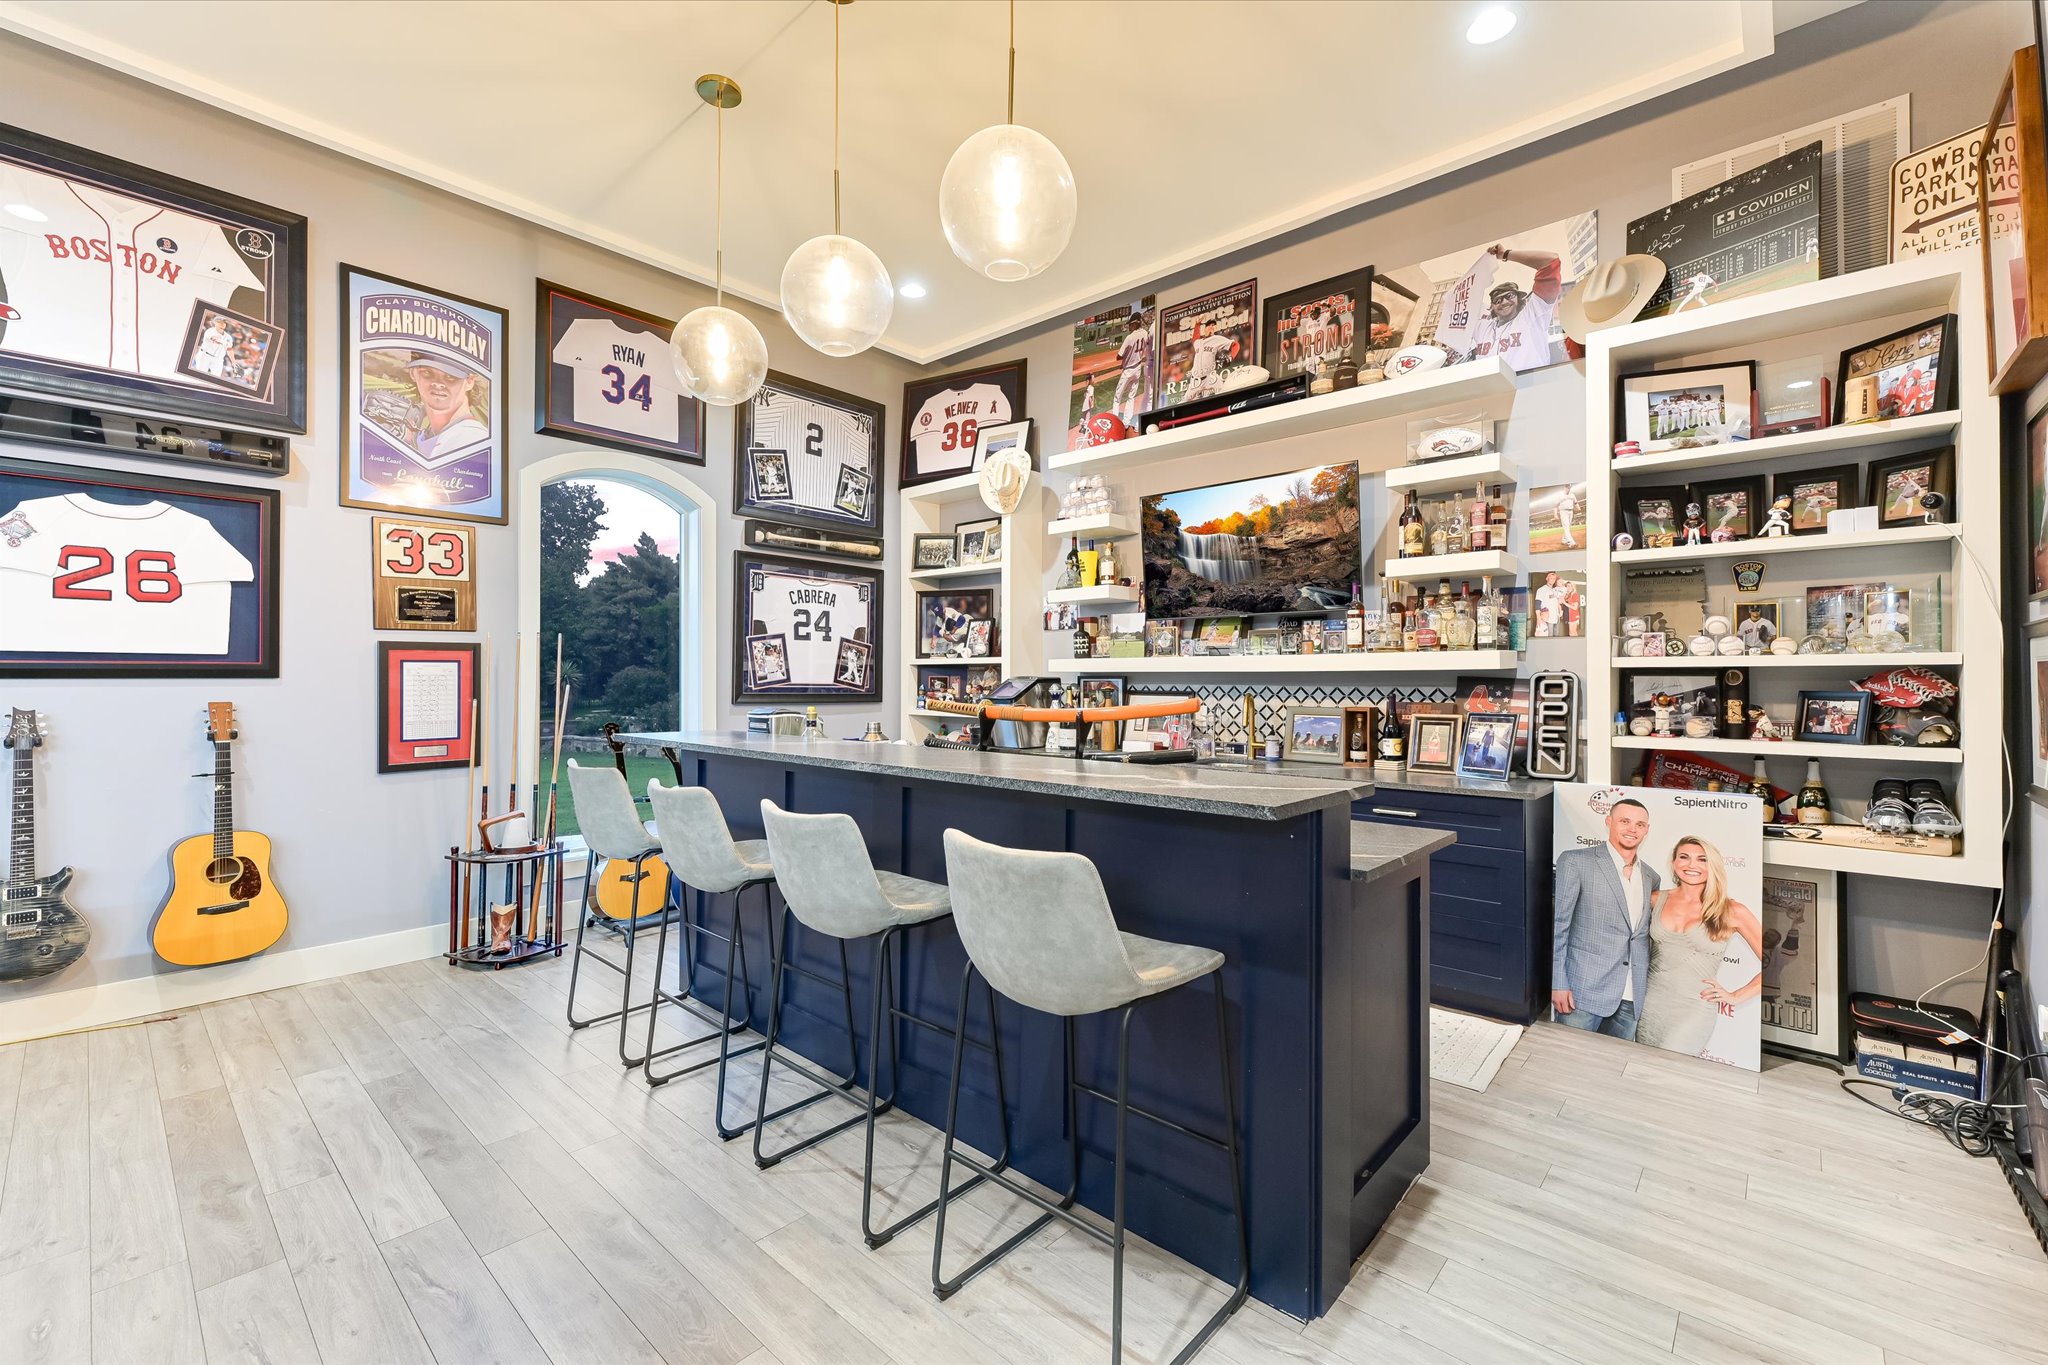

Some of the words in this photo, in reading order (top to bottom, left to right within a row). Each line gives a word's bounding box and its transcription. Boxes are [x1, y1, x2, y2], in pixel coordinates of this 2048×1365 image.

[1900, 140, 1982, 185] COWBO
[1902, 161, 1979, 203] PARKIN
[1738, 181, 1810, 217] COVIDIEN
[1901, 235, 1929, 250] ALL
[1937, 217, 1980, 238] OTHE
[1961, 228, 1979, 241] BE
[44, 234, 182, 285] BOSTON
[376, 298, 408, 306] CLAY
[414, 300, 479, 331] BUCHHOLZ
[1165, 300, 1222, 322] COMMEMORATIVE
[1223, 290, 1252, 305] EDITION
[366, 306, 487, 361] CHARDONCLAY
[1280, 322, 1352, 364] STRONG
[612, 344, 646, 368] RYAN
[601, 364, 652, 412] 34
[1166, 376, 1202, 396] RED
[944, 400, 979, 419] WEAVER
[805, 422, 824, 457] 2
[941, 418, 978, 452] 36
[387, 528, 464, 577] 33
[53, 544, 183, 604] 26
[789, 589, 836, 607] CABRERA
[793, 609, 832, 641] 24
[1536, 679, 1569, 772] OPEN
[1665, 761, 1739, 785] CHAMPIONS
[1674, 795, 1749, 811] SapientNitro
[1773, 885, 1812, 901] Herald
[1723, 956, 1741, 965] owl
[1788, 1004, 1813, 1032] IT!
[1871, 1043, 1893, 1054] AUSTIN
[1919, 1053, 1942, 1064] AUSTIN
[1864, 1067, 1898, 1080] COCKTAILS
[1866, 1059, 1895, 1072] AUSTIN
[1902, 1070, 1917, 1079] REAL
[1917, 1074, 1938, 1083] SPIRITS
[1947, 1080, 1962, 1088] REAL
